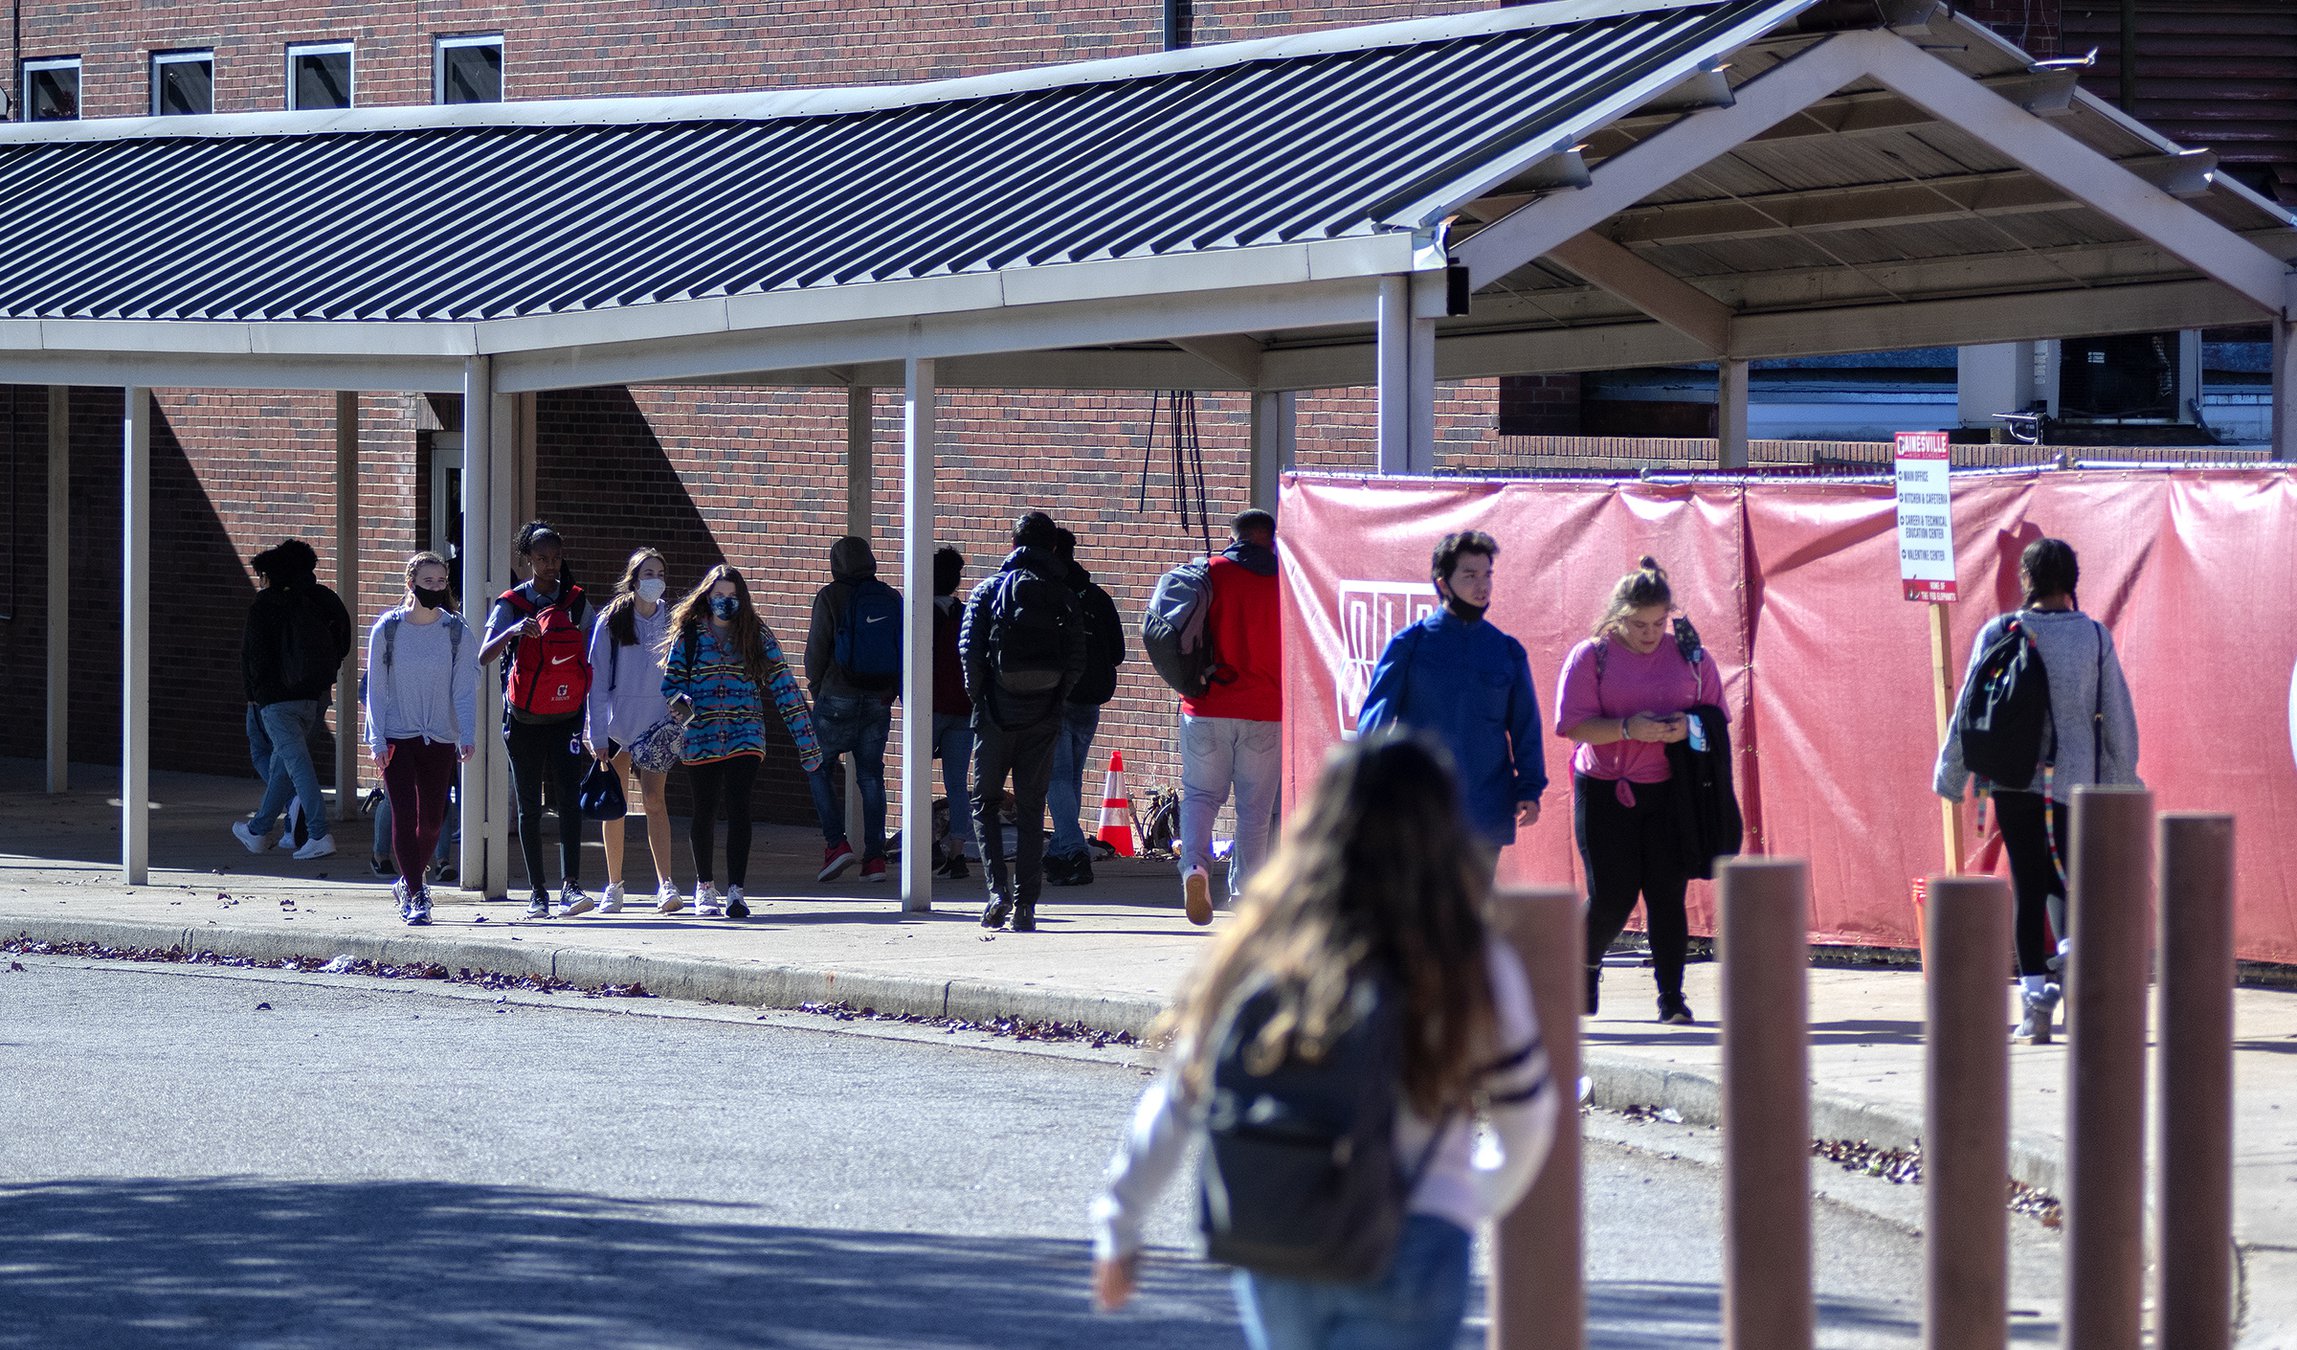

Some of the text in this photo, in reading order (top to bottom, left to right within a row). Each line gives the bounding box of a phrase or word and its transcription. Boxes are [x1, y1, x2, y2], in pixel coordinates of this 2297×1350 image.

[1897, 436, 1947, 455] GAINESVILLE
[1904, 471, 1928, 482] MAIN OFFICE
[1905, 493, 1920, 504] KITCHEN
[1926, 494, 1947, 504] CAFETERIA
[1905, 515, 1920, 526] CAREER
[1925, 516, 1947, 527] TECHNICAL
[1906, 528, 1944, 539] EDUCATION CENTER
[1908, 549, 1945, 561] VALENTINE CENTER
